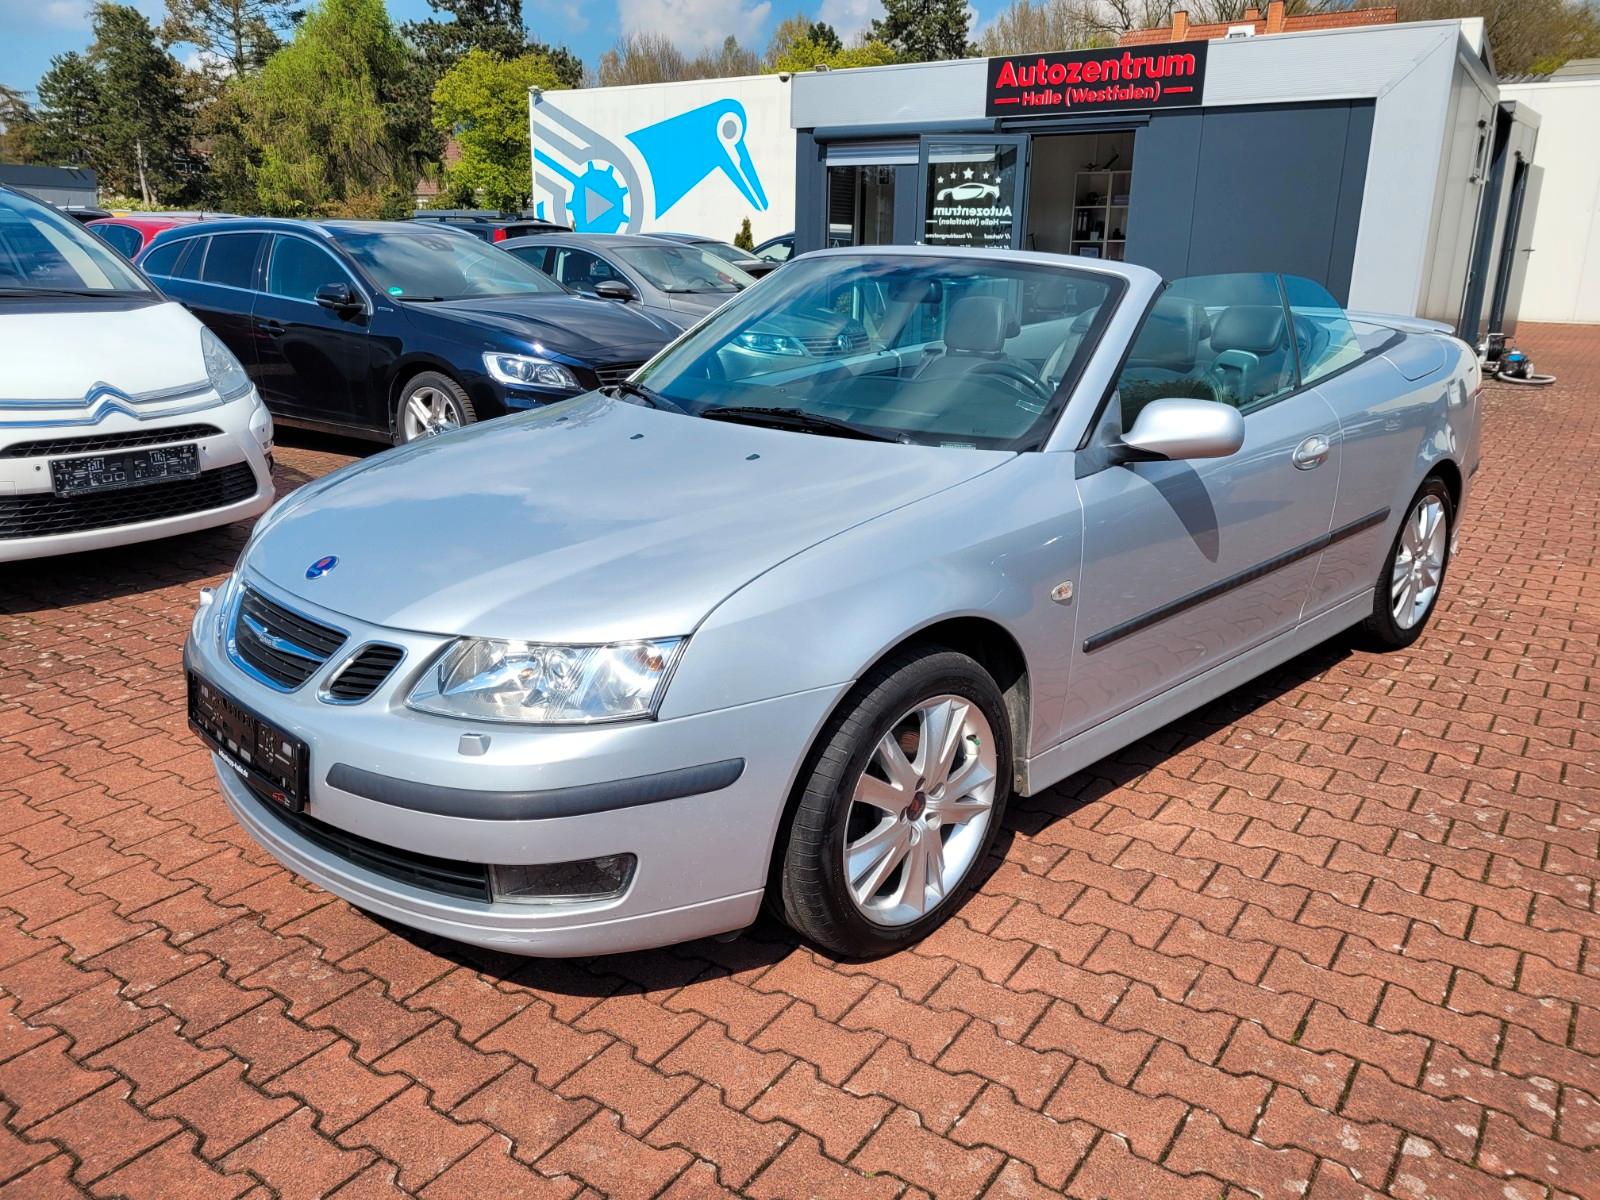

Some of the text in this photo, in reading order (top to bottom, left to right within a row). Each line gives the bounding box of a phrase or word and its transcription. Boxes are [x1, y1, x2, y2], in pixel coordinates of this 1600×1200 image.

[995, 51, 1195, 88] Autozentrum
[1021, 81, 1160, 107] Halle (Westfalen)
